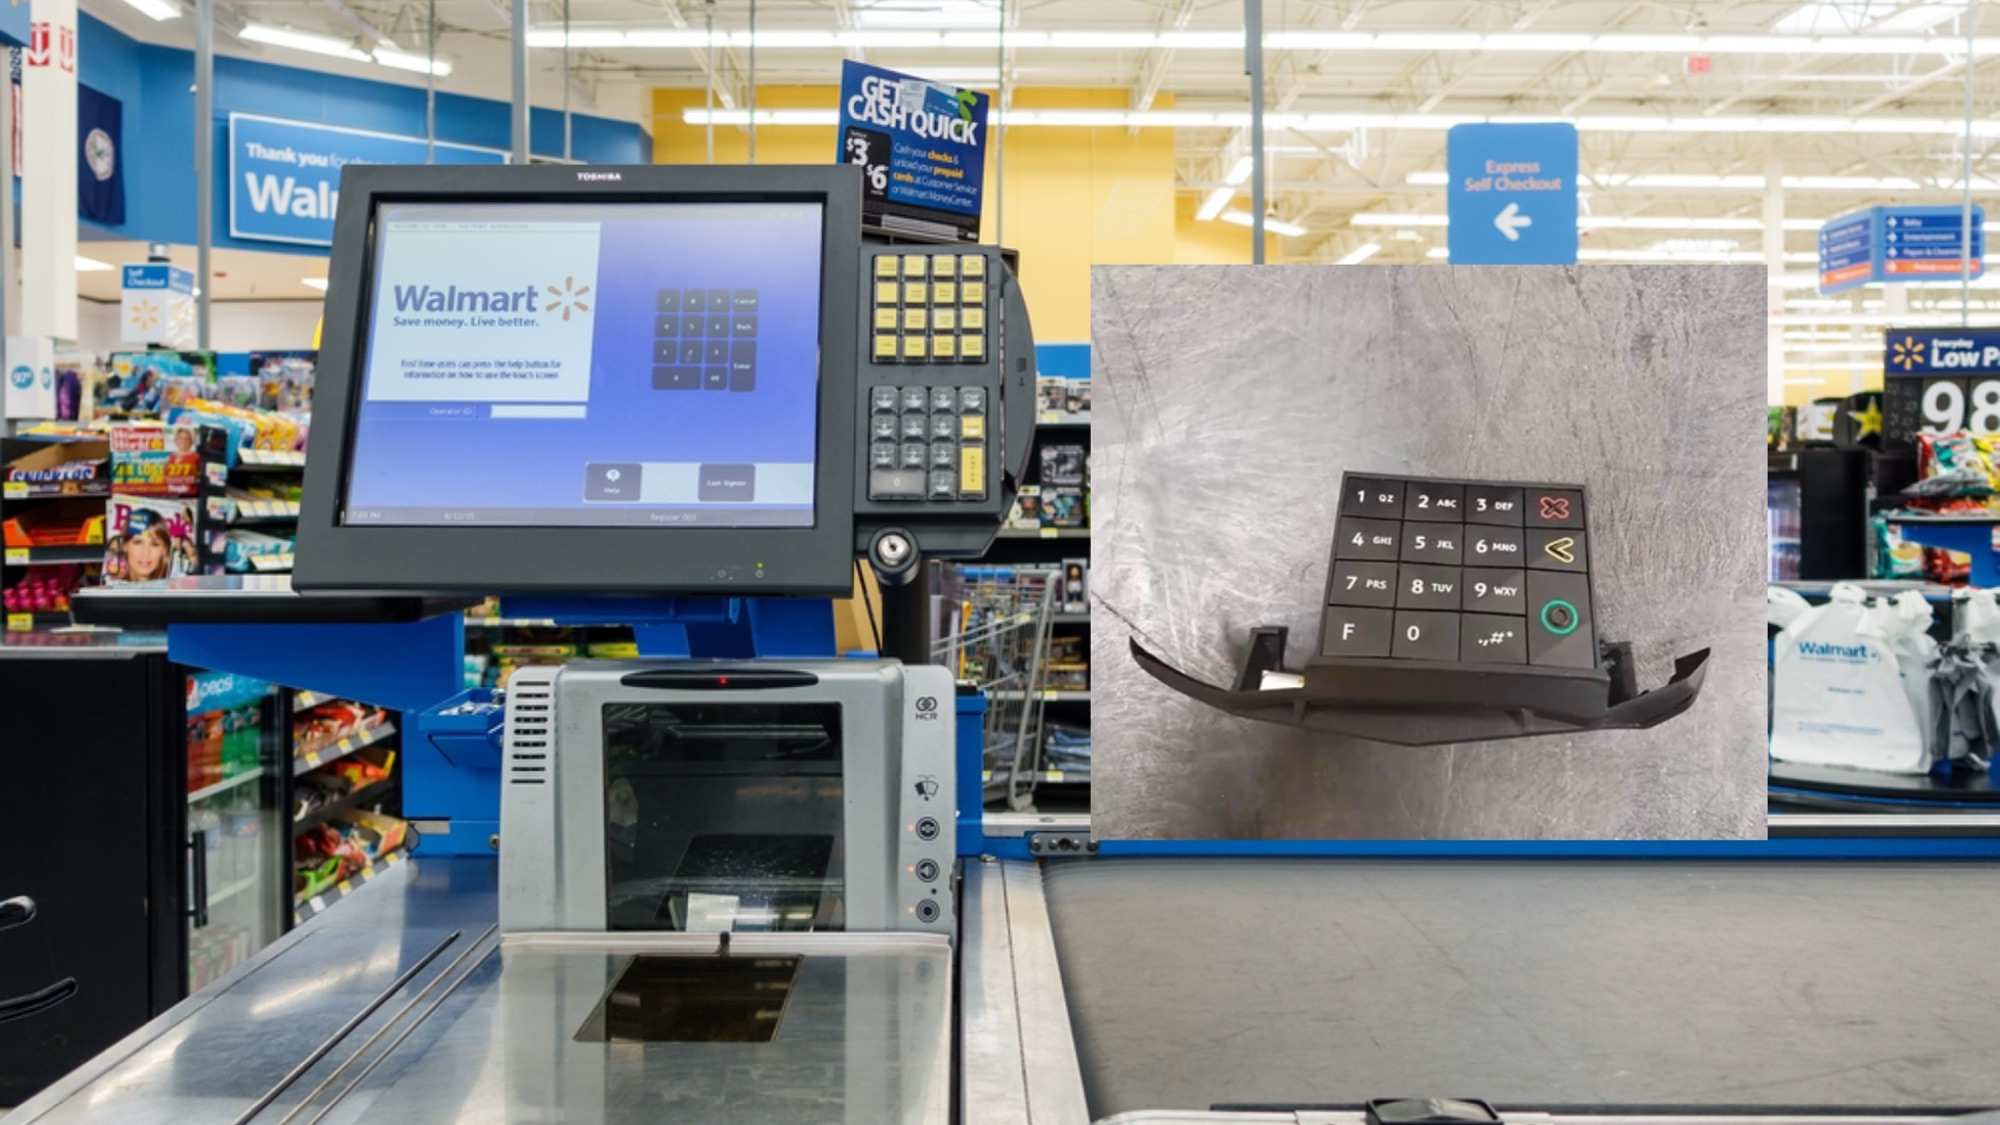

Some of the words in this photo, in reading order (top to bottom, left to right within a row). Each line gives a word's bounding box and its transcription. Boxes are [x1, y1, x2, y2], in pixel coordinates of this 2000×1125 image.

[861, 76, 904, 107] GET
[848, 95, 906, 130] CASH
[911, 110, 978, 146] QUICK
[246, 142, 296, 163] Thank
[298, 152, 328, 167] you
[1485, 159, 1540, 175] Express
[577, 172, 621, 181] TOSHIBA
[1464, 177, 1492, 192] Self
[1495, 176, 1562, 191] Checkout
[245, 172, 338, 219] Wal
[394, 285, 539, 312] Walmart
[393, 316, 421, 327] Save
[424, 317, 468, 329] money.
[470, 316, 496, 327] Live
[498, 316, 539, 327] better.
[1931, 338, 1974, 349] Everyday
[1931, 347, 1980, 367] Low
[1983, 346, 2000, 367] P
[429, 407, 461, 417] Operator
[1357, 490, 1365, 503] 1
[1379, 494, 1394, 504] QZ
[1418, 495, 1429, 509] 2
[1436, 499, 1457, 509] ABC
[1476, 498, 1487, 512] 3
[1495, 502, 1514, 511] DEF
[1352, 532, 1364, 546] 4
[1373, 536, 1392, 546] GHI
[1414, 536, 1426, 549] 5
[1437, 540, 1454, 549] JKL
[1476, 539, 1487, 553] 6
[1492, 543, 1517, 552] MNO
[1346, 576, 1358, 590] 7
[1366, 579, 1387, 590] PRS
[1411, 579, 1424, 594] 8
[1432, 583, 1453, 593] TUV
[1474, 583, 1487, 597] 9
[1494, 585, 1517, 596] WXY
[1342, 623, 1355, 640] F
[1407, 625, 1420, 641] 0
[1798, 641, 1867, 657] Walmart
[201, 673, 233, 698] pepsi
[915, 712, 938, 720] NCR
